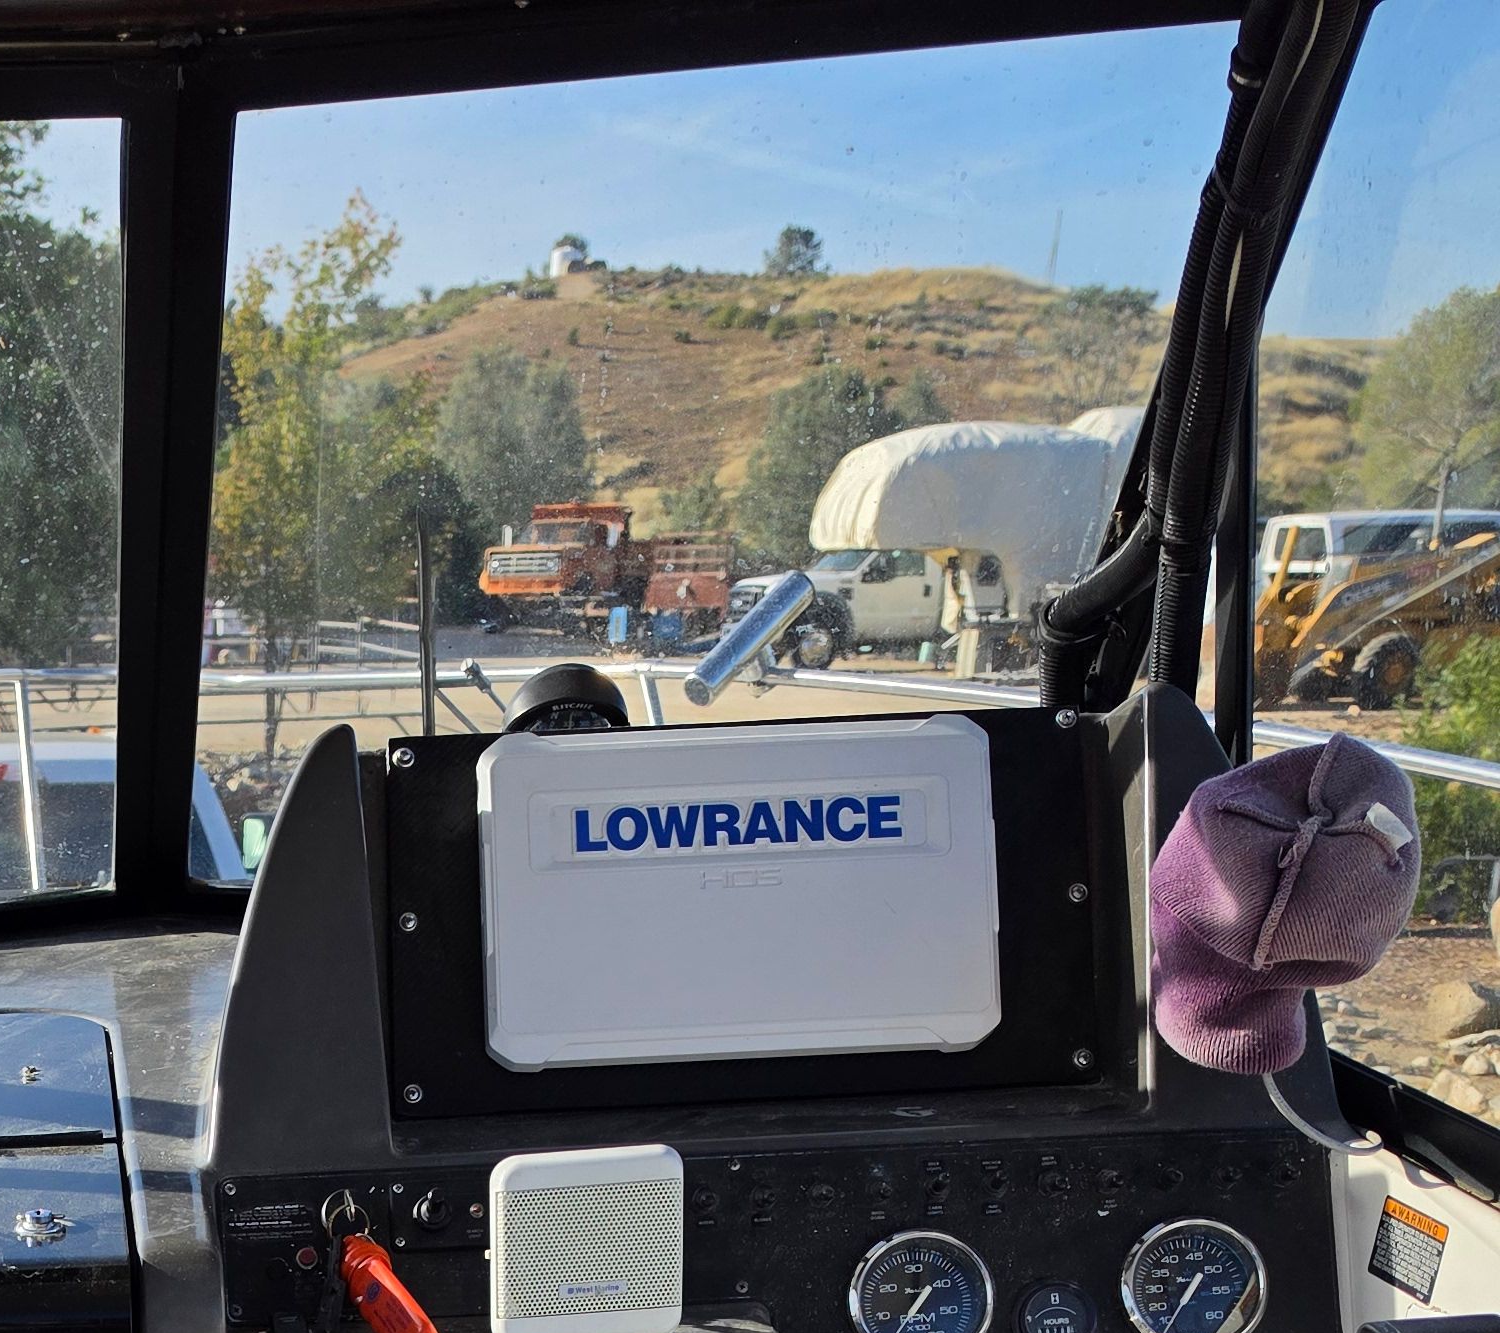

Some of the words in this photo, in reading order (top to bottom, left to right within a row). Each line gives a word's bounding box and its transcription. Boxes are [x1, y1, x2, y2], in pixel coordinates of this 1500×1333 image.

[552, 703, 594, 711] RITCHIE
[574, 794, 903, 854] LOWRANCE
[1397, 1205, 1440, 1237] WARNING
[1160, 1255, 1179, 1264] 40
[1185, 1252, 1204, 1261] 45
[904, 1264, 923, 1274] 30
[1151, 1269, 1169, 1277] 35
[1204, 1265, 1223, 1274] 50
[932, 1279, 951, 1288] 40
[879, 1284, 898, 1293] 20
[1145, 1284, 1164, 1293] 30
[1211, 1285, 1230, 1294] 55
[939, 1306, 958, 1315] 50
[1148, 1302, 1167, 1311] 20
[876, 1312, 891, 1320] 10
[900, 1312, 936, 1323] RPM
[1205, 1311, 1224, 1320] 60
[1043, 1317, 1070, 1325] HOURS
[1158, 1316, 1173, 1325] 10
